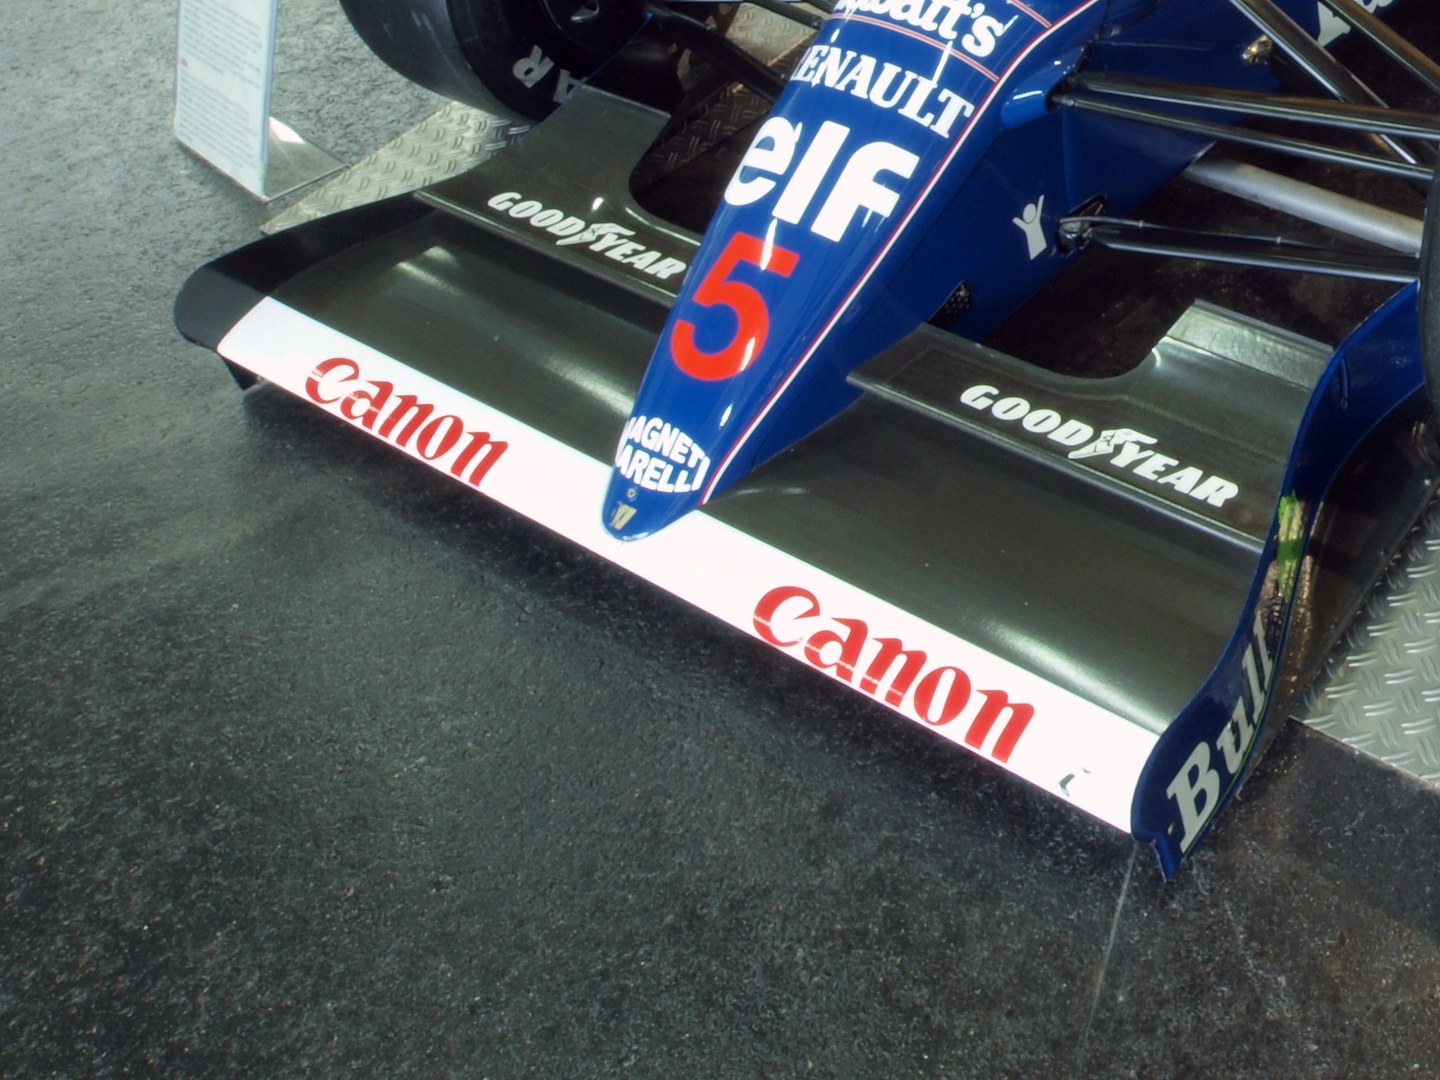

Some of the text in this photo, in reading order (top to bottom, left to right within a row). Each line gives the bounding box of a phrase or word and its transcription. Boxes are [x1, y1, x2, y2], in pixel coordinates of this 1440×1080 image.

[487, 191, 688, 281] GOODYEAR
[724, 116, 920, 243] elf
[671, 231, 800, 381] 5
[305, 357, 509, 487] Canon
[959, 384, 1239, 508] GOODYEAR
[752, 585, 1035, 764] Canon
[1166, 612, 1280, 854] Bull
